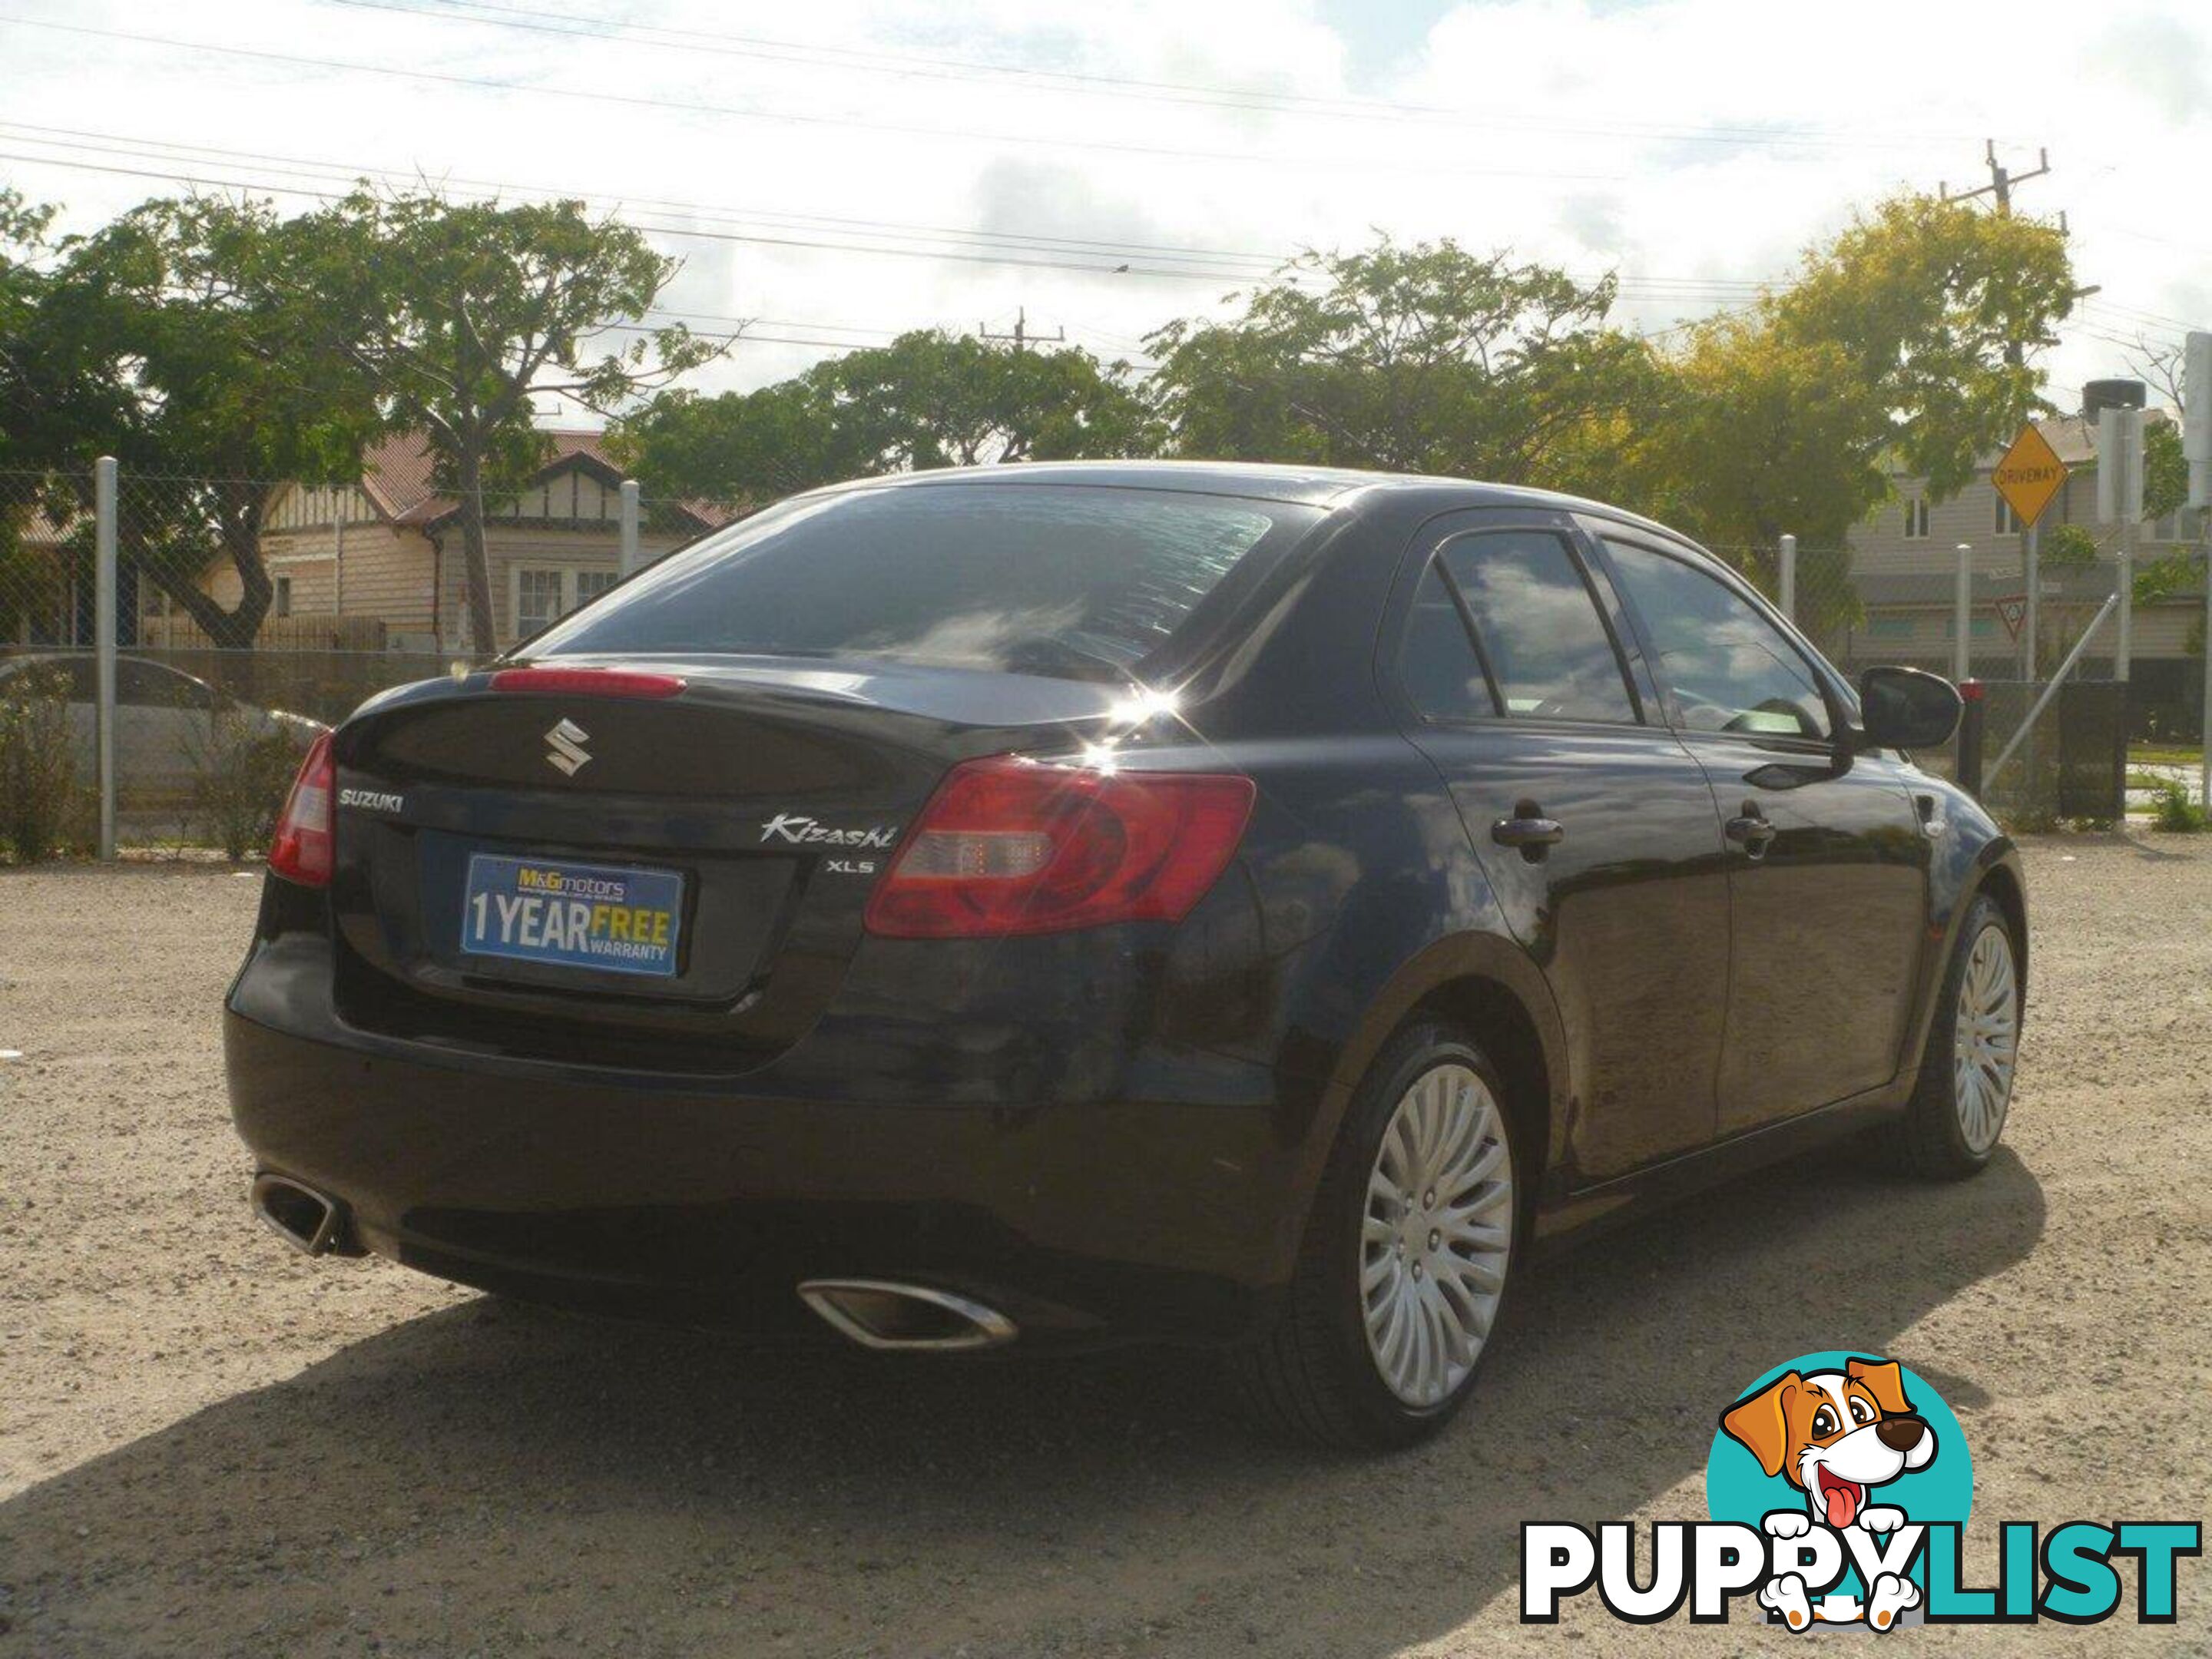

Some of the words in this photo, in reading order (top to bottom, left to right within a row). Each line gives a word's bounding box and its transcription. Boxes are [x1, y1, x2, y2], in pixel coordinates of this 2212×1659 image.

[1998, 467, 2058, 485] DRIVEWAY
[339, 789, 404, 813] SUZUKI
[826, 859, 876, 873] XLS
[472, 892, 488, 941] 1
[495, 893, 591, 952] YEAR
[589, 904, 671, 945] FREE
[590, 938, 667, 961] WARRANTY
